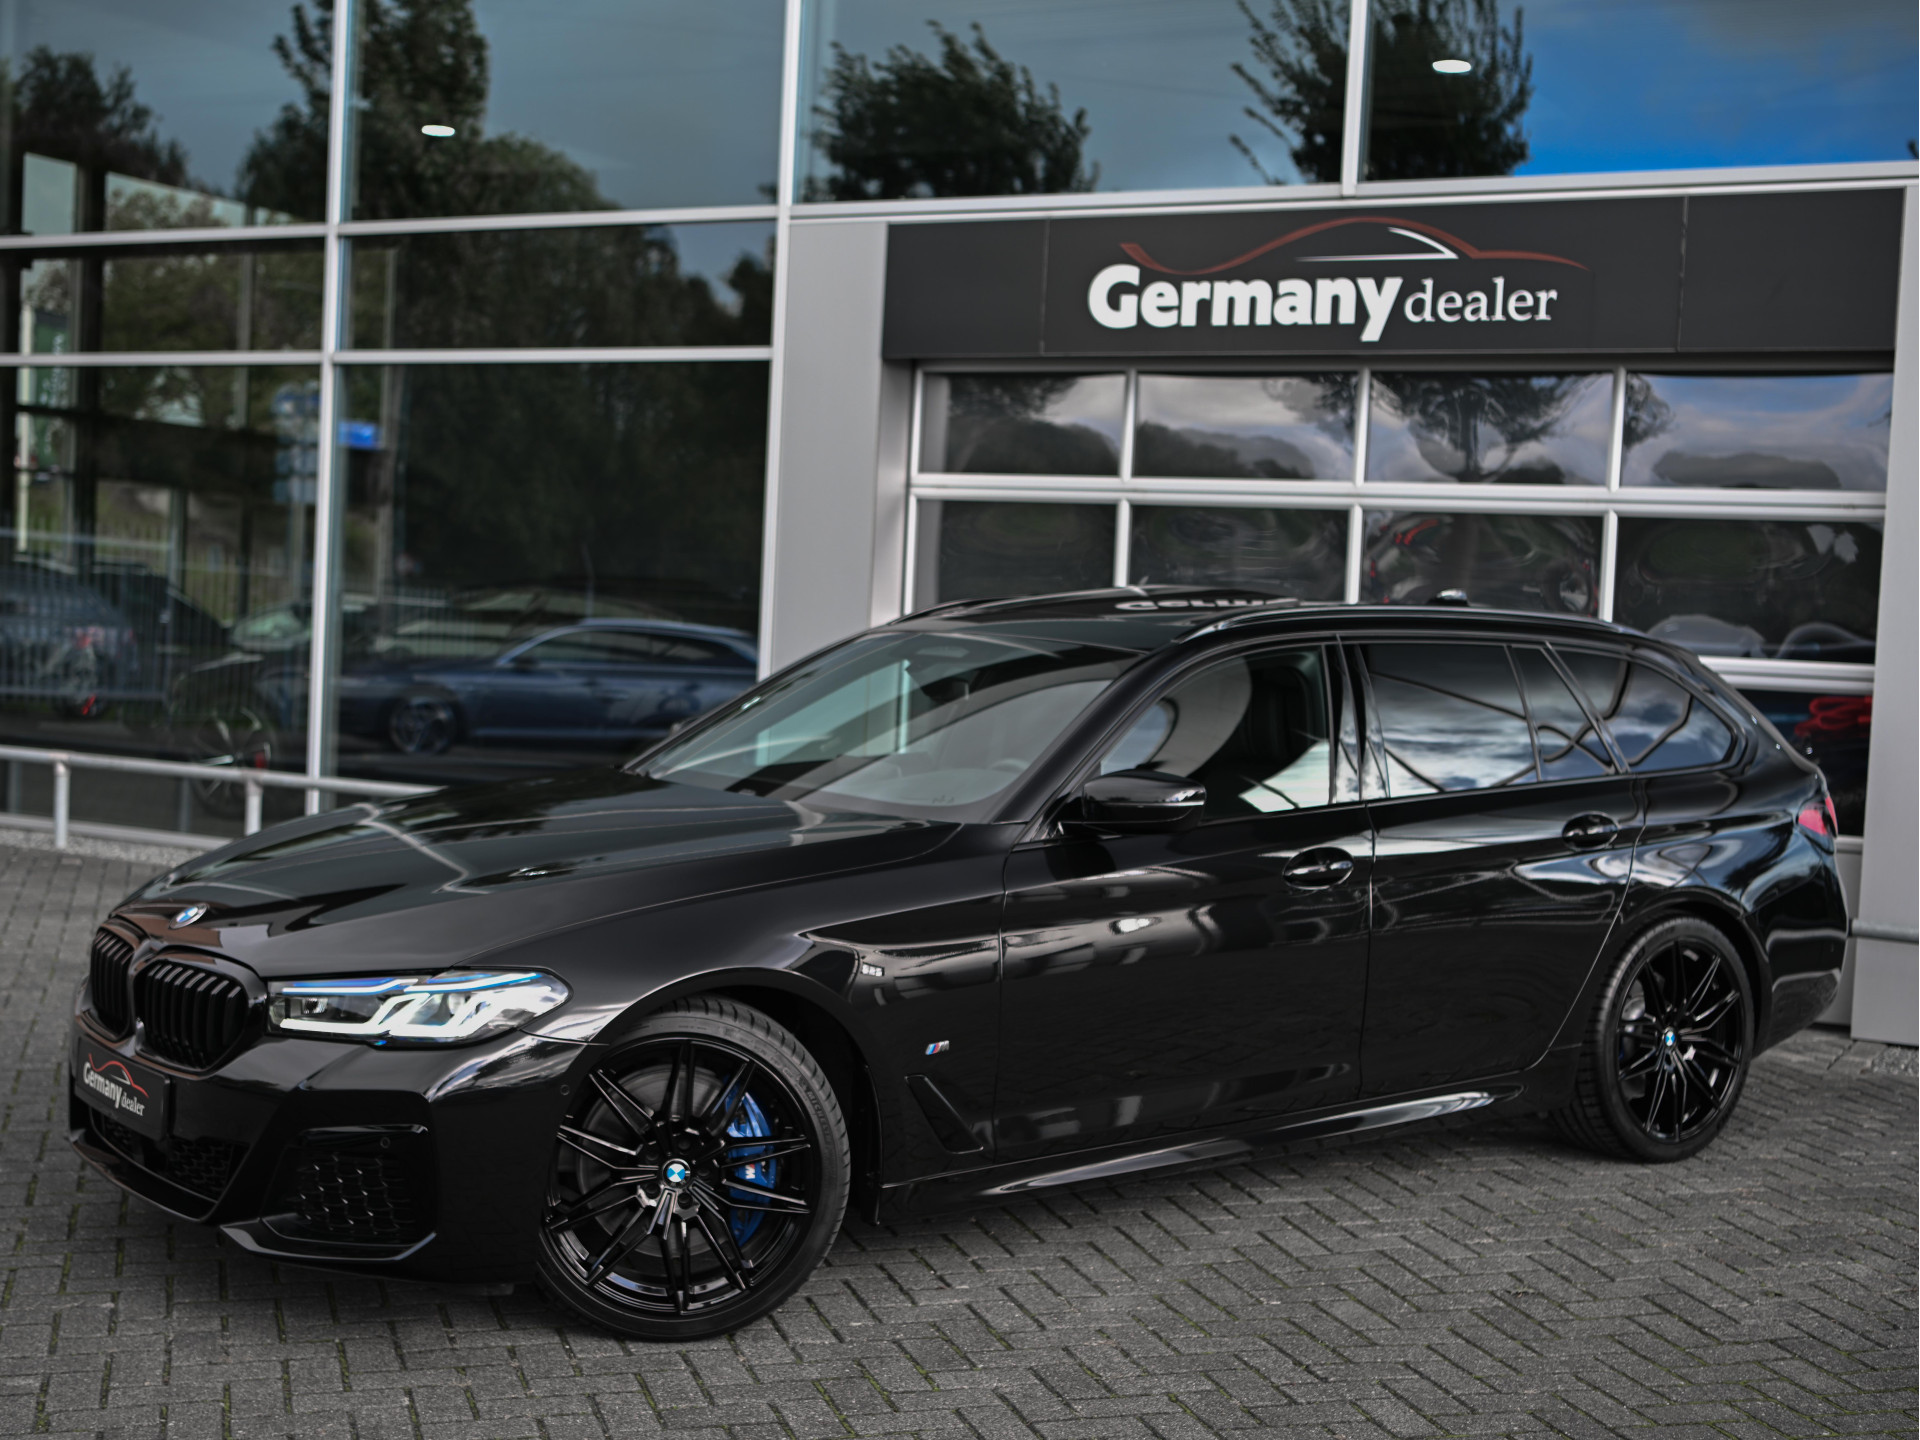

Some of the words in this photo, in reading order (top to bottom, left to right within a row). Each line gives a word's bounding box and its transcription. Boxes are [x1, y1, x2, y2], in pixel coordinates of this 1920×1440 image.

[1087, 264, 1403, 342] Germany
[1403, 277, 1558, 323] dealer
[83, 1062, 122, 1109] Germany
[121, 1091, 146, 1116] dealer
